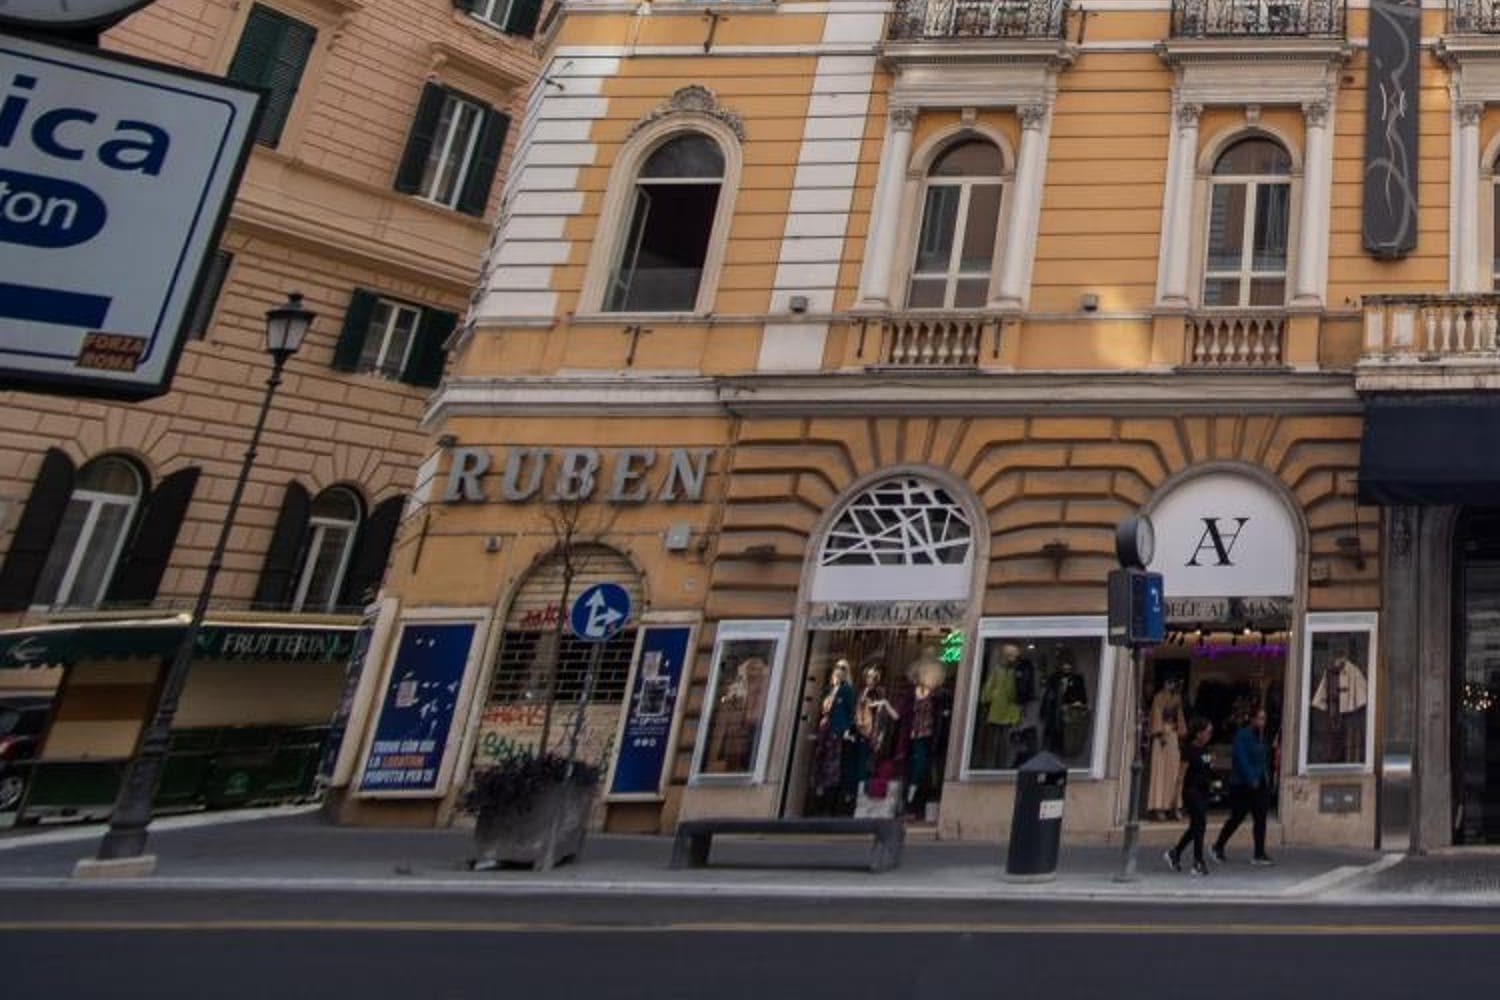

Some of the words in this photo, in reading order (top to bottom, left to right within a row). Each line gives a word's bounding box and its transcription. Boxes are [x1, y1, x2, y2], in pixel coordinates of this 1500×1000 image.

[0, 73, 171, 176] ica
[86, 334, 144, 353] FORZA
[81, 352, 135, 371] ROMA
[443, 446, 714, 504] RUBEN
[1163, 601, 1206, 618] DELE
[222, 633, 325, 656] FRUTTERIA
